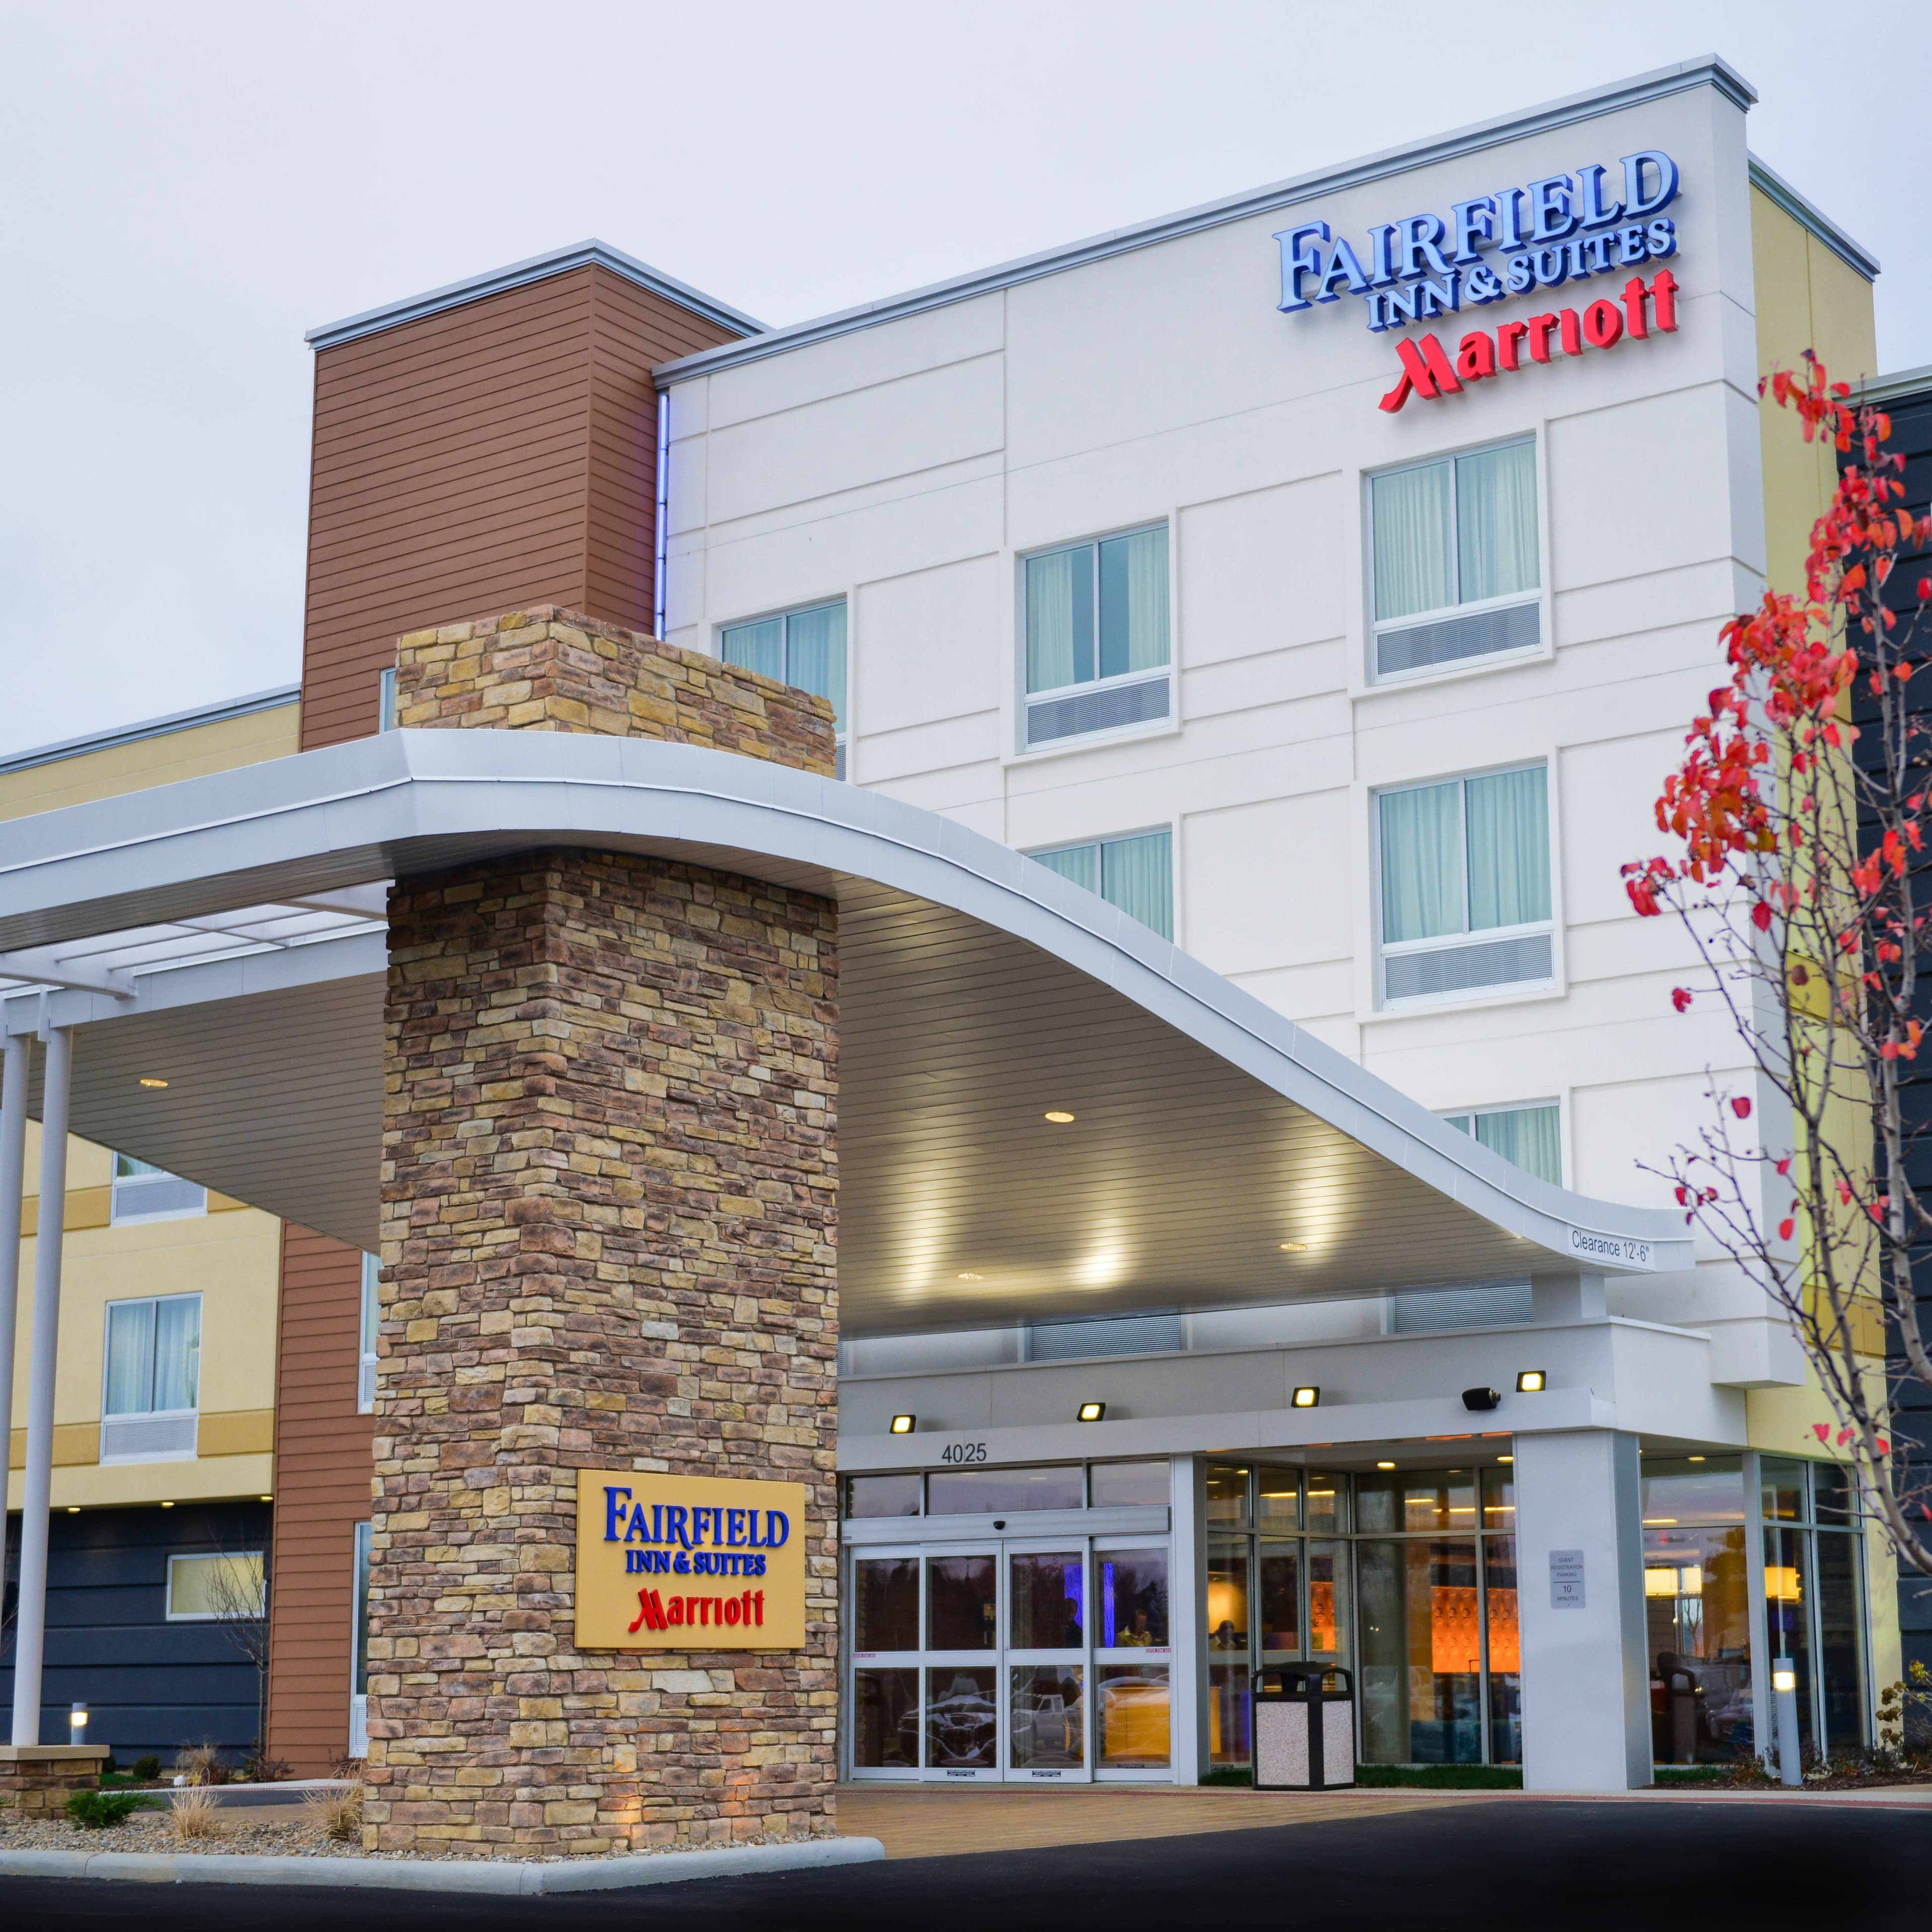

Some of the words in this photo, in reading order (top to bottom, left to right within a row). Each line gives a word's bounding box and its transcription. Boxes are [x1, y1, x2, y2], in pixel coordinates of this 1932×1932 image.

[1272, 150, 1679, 314] FAIRFIELD
[1378, 268, 1680, 414] Marriott
[1572, 1230, 1620, 1256] Clearance
[941, 1442, 987, 1464] 4025
[603, 1486, 790, 1550] FAIRFIELD
[628, 1587, 765, 1633] Marriott
[1563, 1585, 1572, 1593] 10
